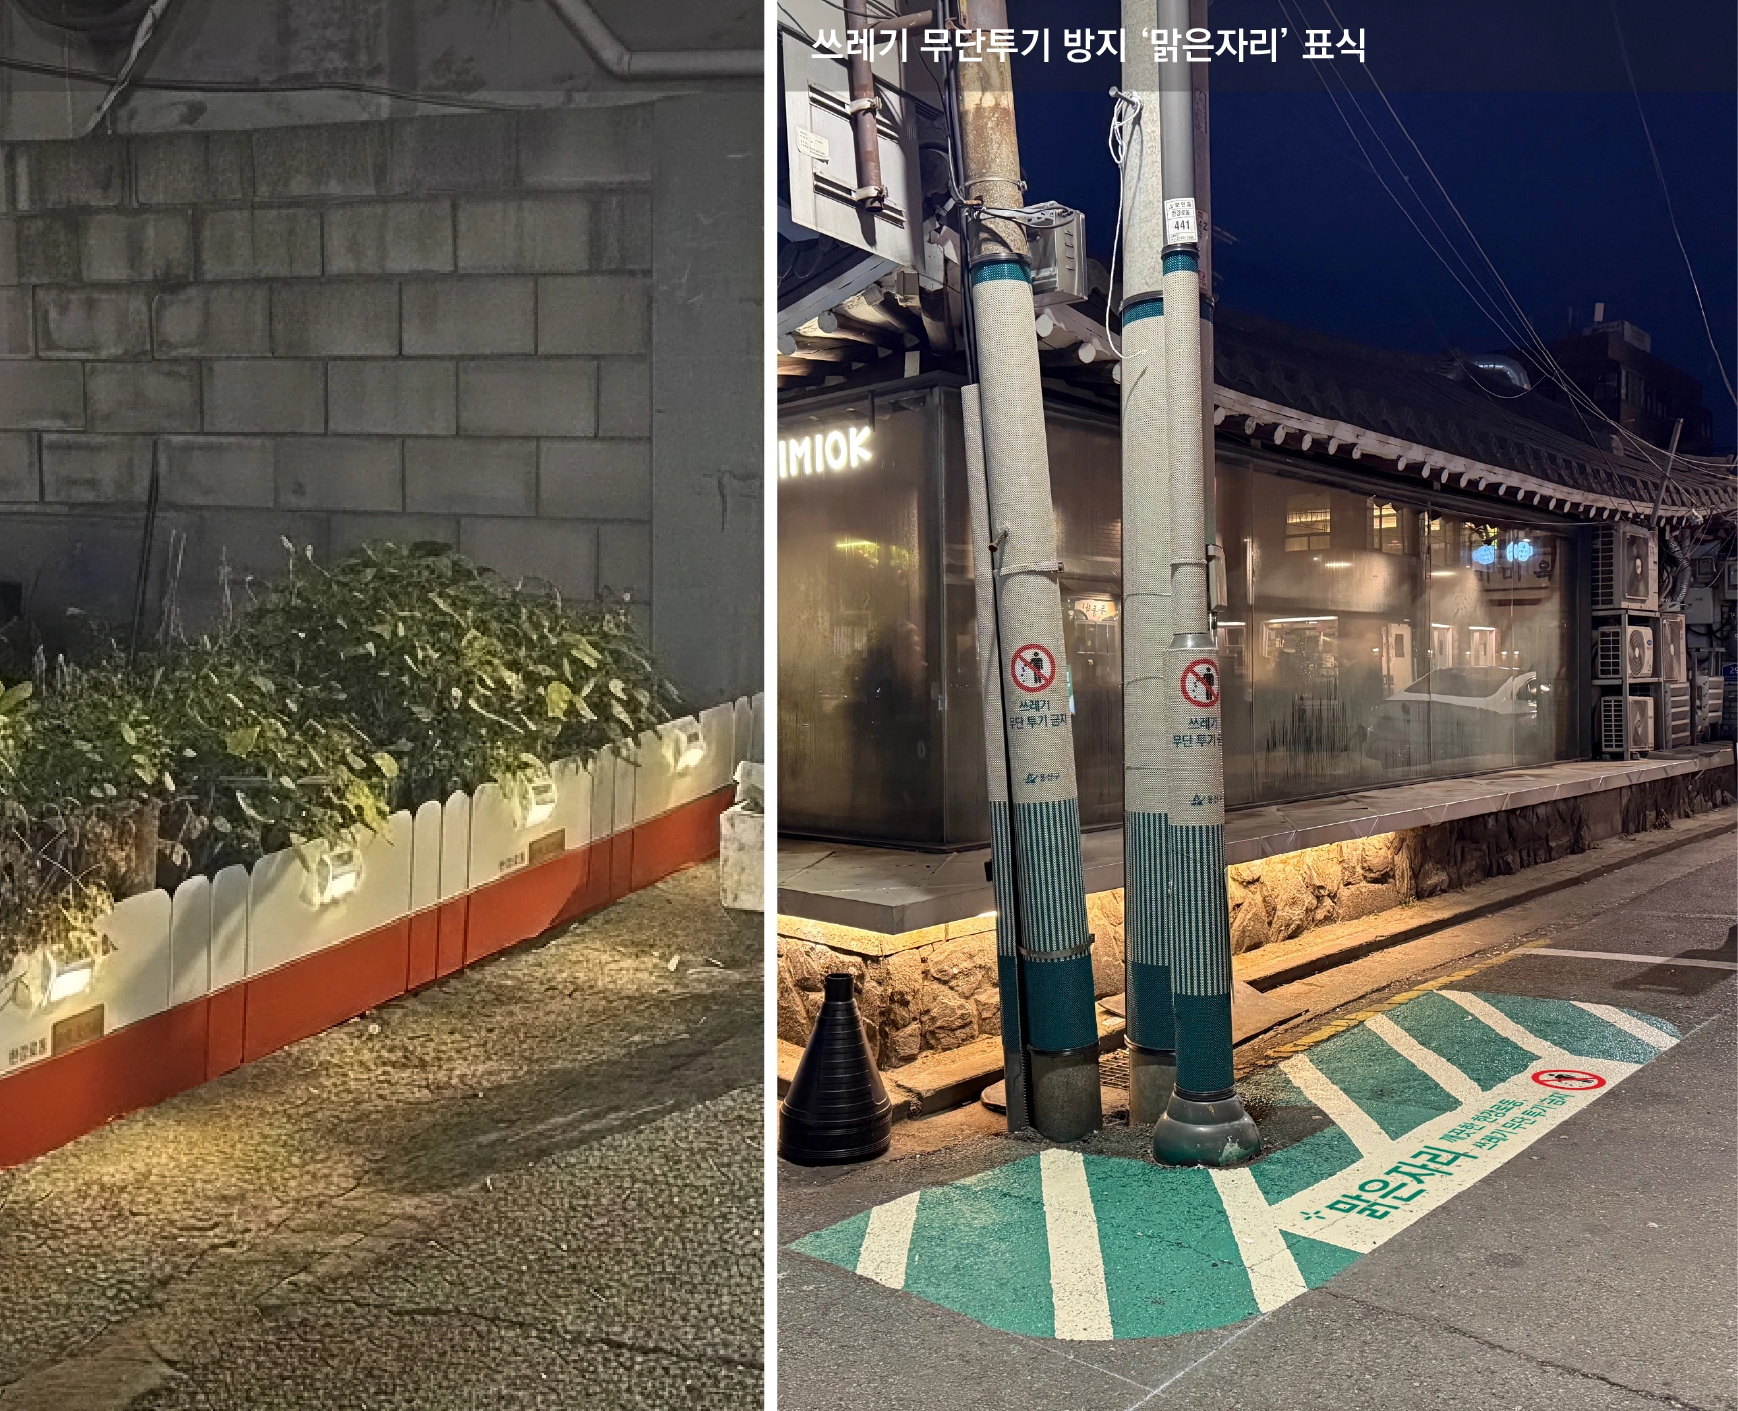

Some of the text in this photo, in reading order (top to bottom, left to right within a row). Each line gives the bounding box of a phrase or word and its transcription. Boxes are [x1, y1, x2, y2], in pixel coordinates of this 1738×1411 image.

[1174, 219, 1190, 231] 441
[778, 426, 873, 479] IMIOK
[1019, 699, 1051, 712] 쓰레기
[1009, 712, 1068, 730] 무단 투기 금지
[1173, 734, 1193, 749] 무단
[1196, 733, 1216, 747] 투기
[1471, 1091, 1576, 1151] 쓰레기 무단 투기 금지
[1438, 1121, 1487, 1143] 깨끗한
[1325, 1144, 1479, 1221] 맑은자리
